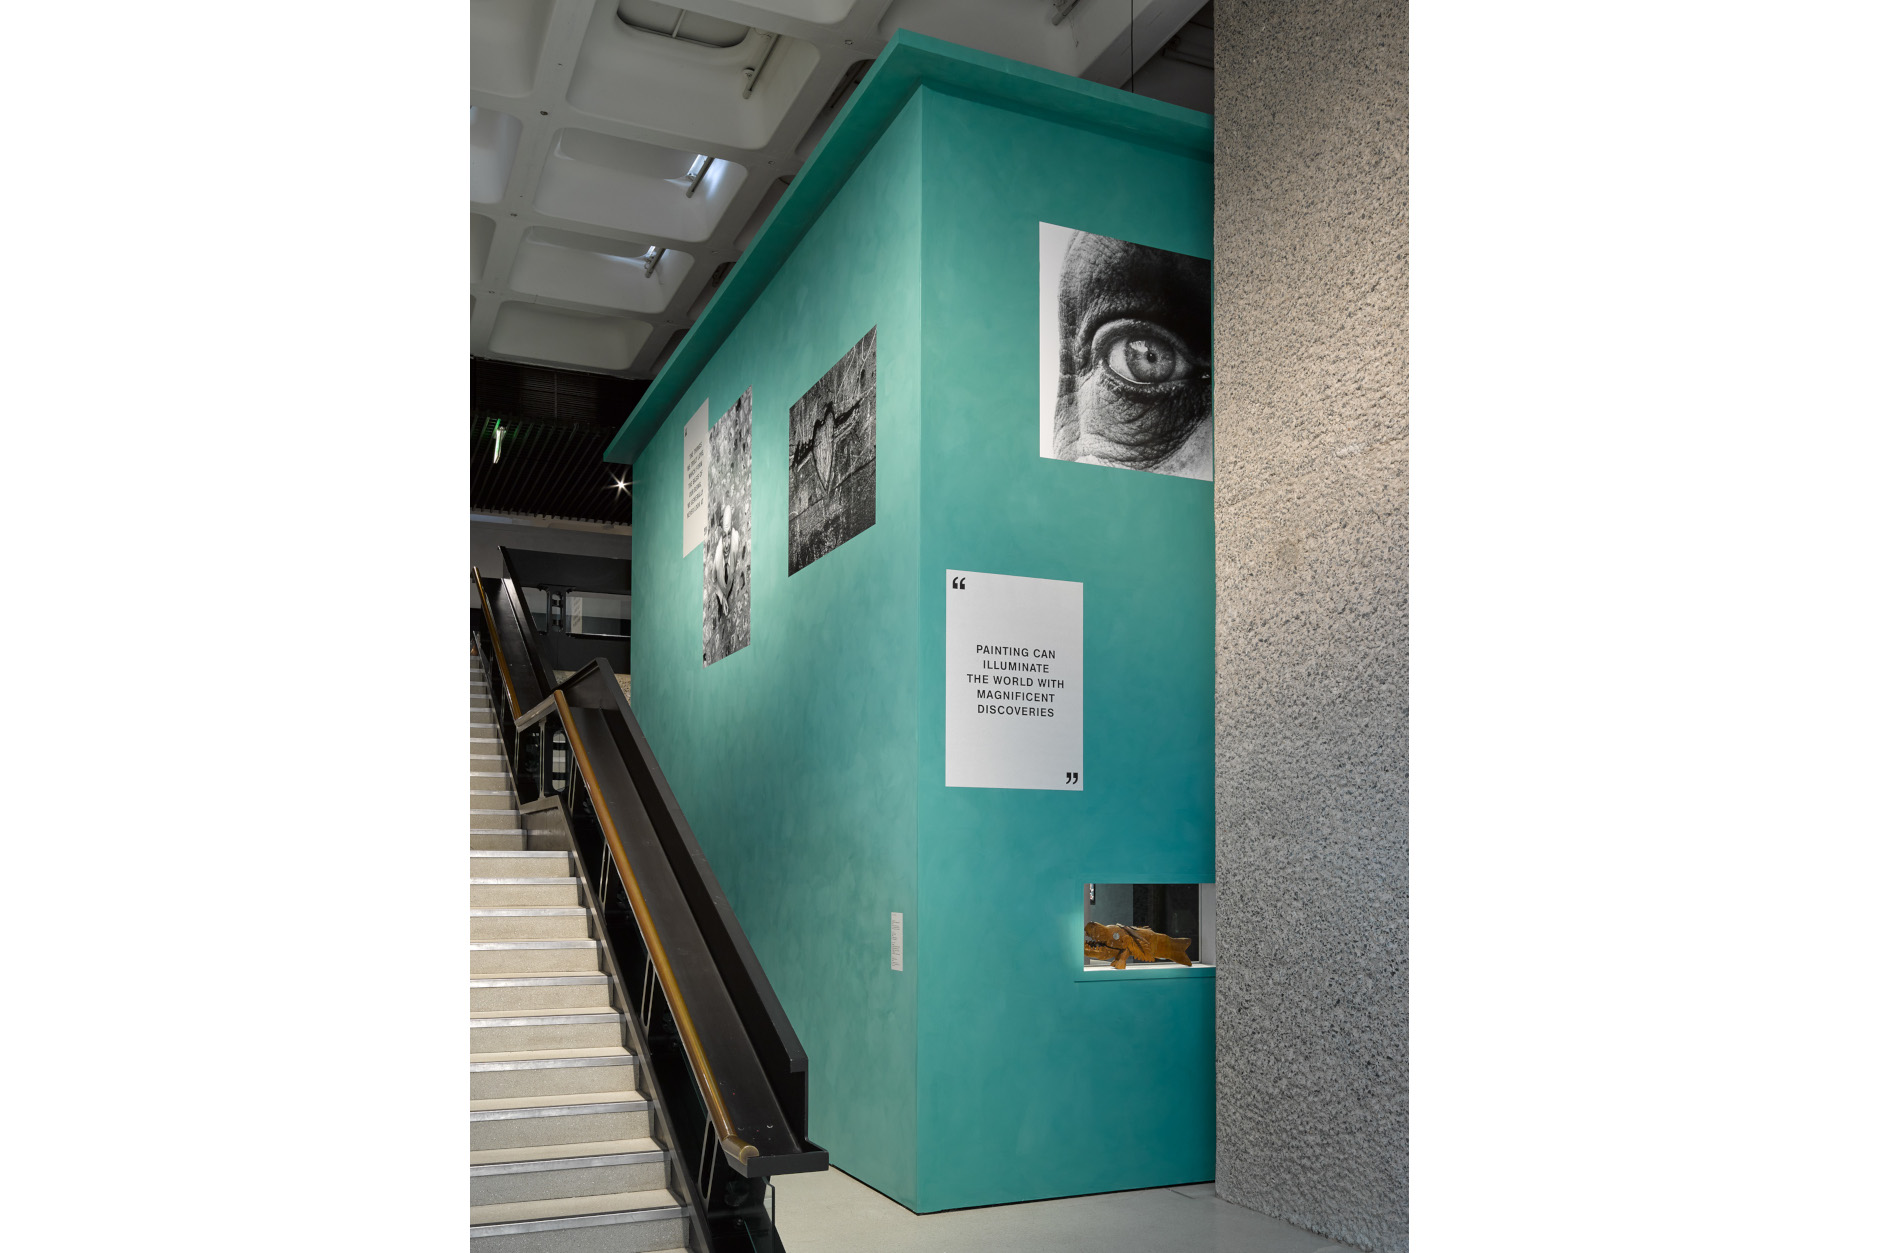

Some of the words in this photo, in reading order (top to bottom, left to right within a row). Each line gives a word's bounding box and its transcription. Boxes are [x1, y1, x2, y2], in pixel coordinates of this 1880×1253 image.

[976, 644, 1029, 658] PAINTING
[1033, 648, 1056, 659] CAN
[983, 659, 1050, 674] ILLUMINATE
[966, 673, 989, 684] THE
[992, 675, 1034, 687] WORLD
[1037, 678, 1064, 689] WITH
[977, 689, 1055, 703] MAGNIFICENT
[977, 704, 1055, 718] DISCOVERIES
